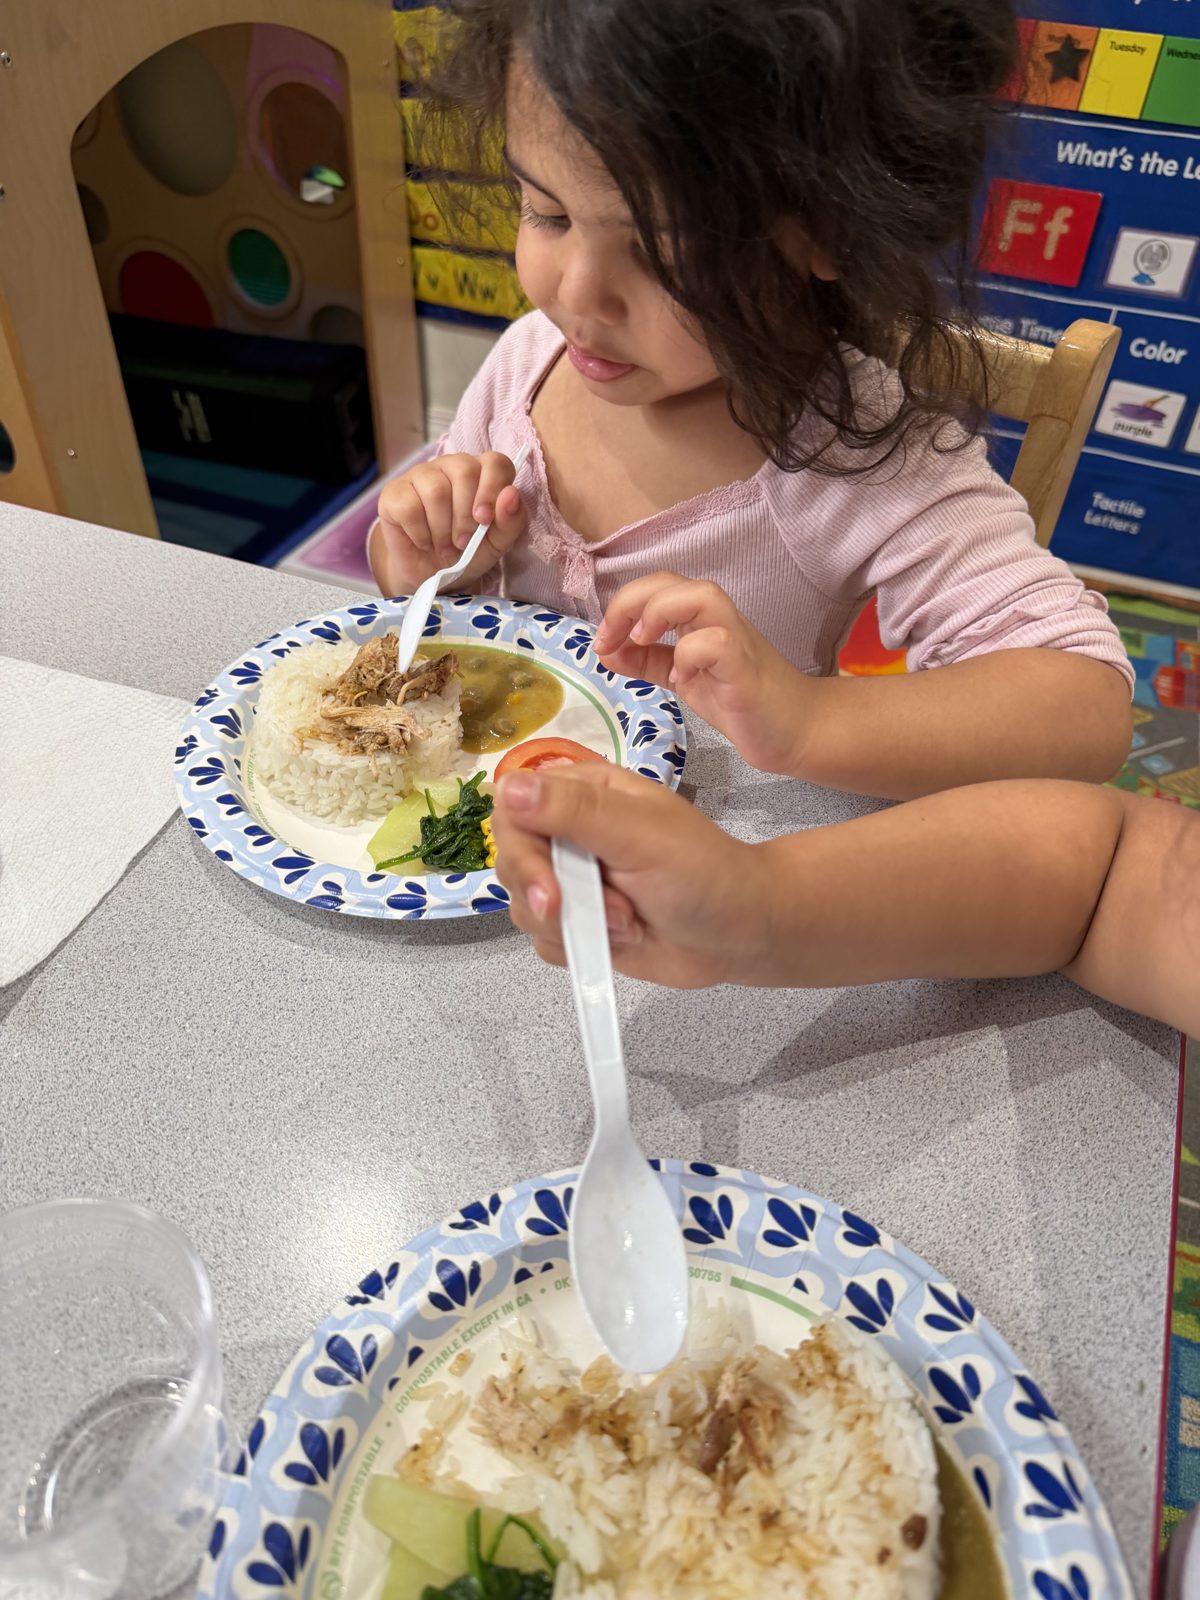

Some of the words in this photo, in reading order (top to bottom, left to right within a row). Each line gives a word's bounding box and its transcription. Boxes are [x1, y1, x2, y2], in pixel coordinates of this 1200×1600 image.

[1109, 41, 1147, 56] Tuesday
[1056, 140, 1135, 172] What's
[1139, 151, 1179, 177] the
[998, 199, 1073, 261] Ff
[1129, 337, 1188, 365] Color
[1091, 491, 1146, 519] Tactile
[1083, 508, 1140, 536] Letters
[336, 1435, 386, 1538] COMPOSTABLE
[393, 1338, 463, 1415] COMPOSTABLE
[460, 1310, 502, 1344] EXCEPT
[501, 1299, 515, 1316] IN
[516, 1292, 534, 1309] CA
[553, 1275, 572, 1292] OK
